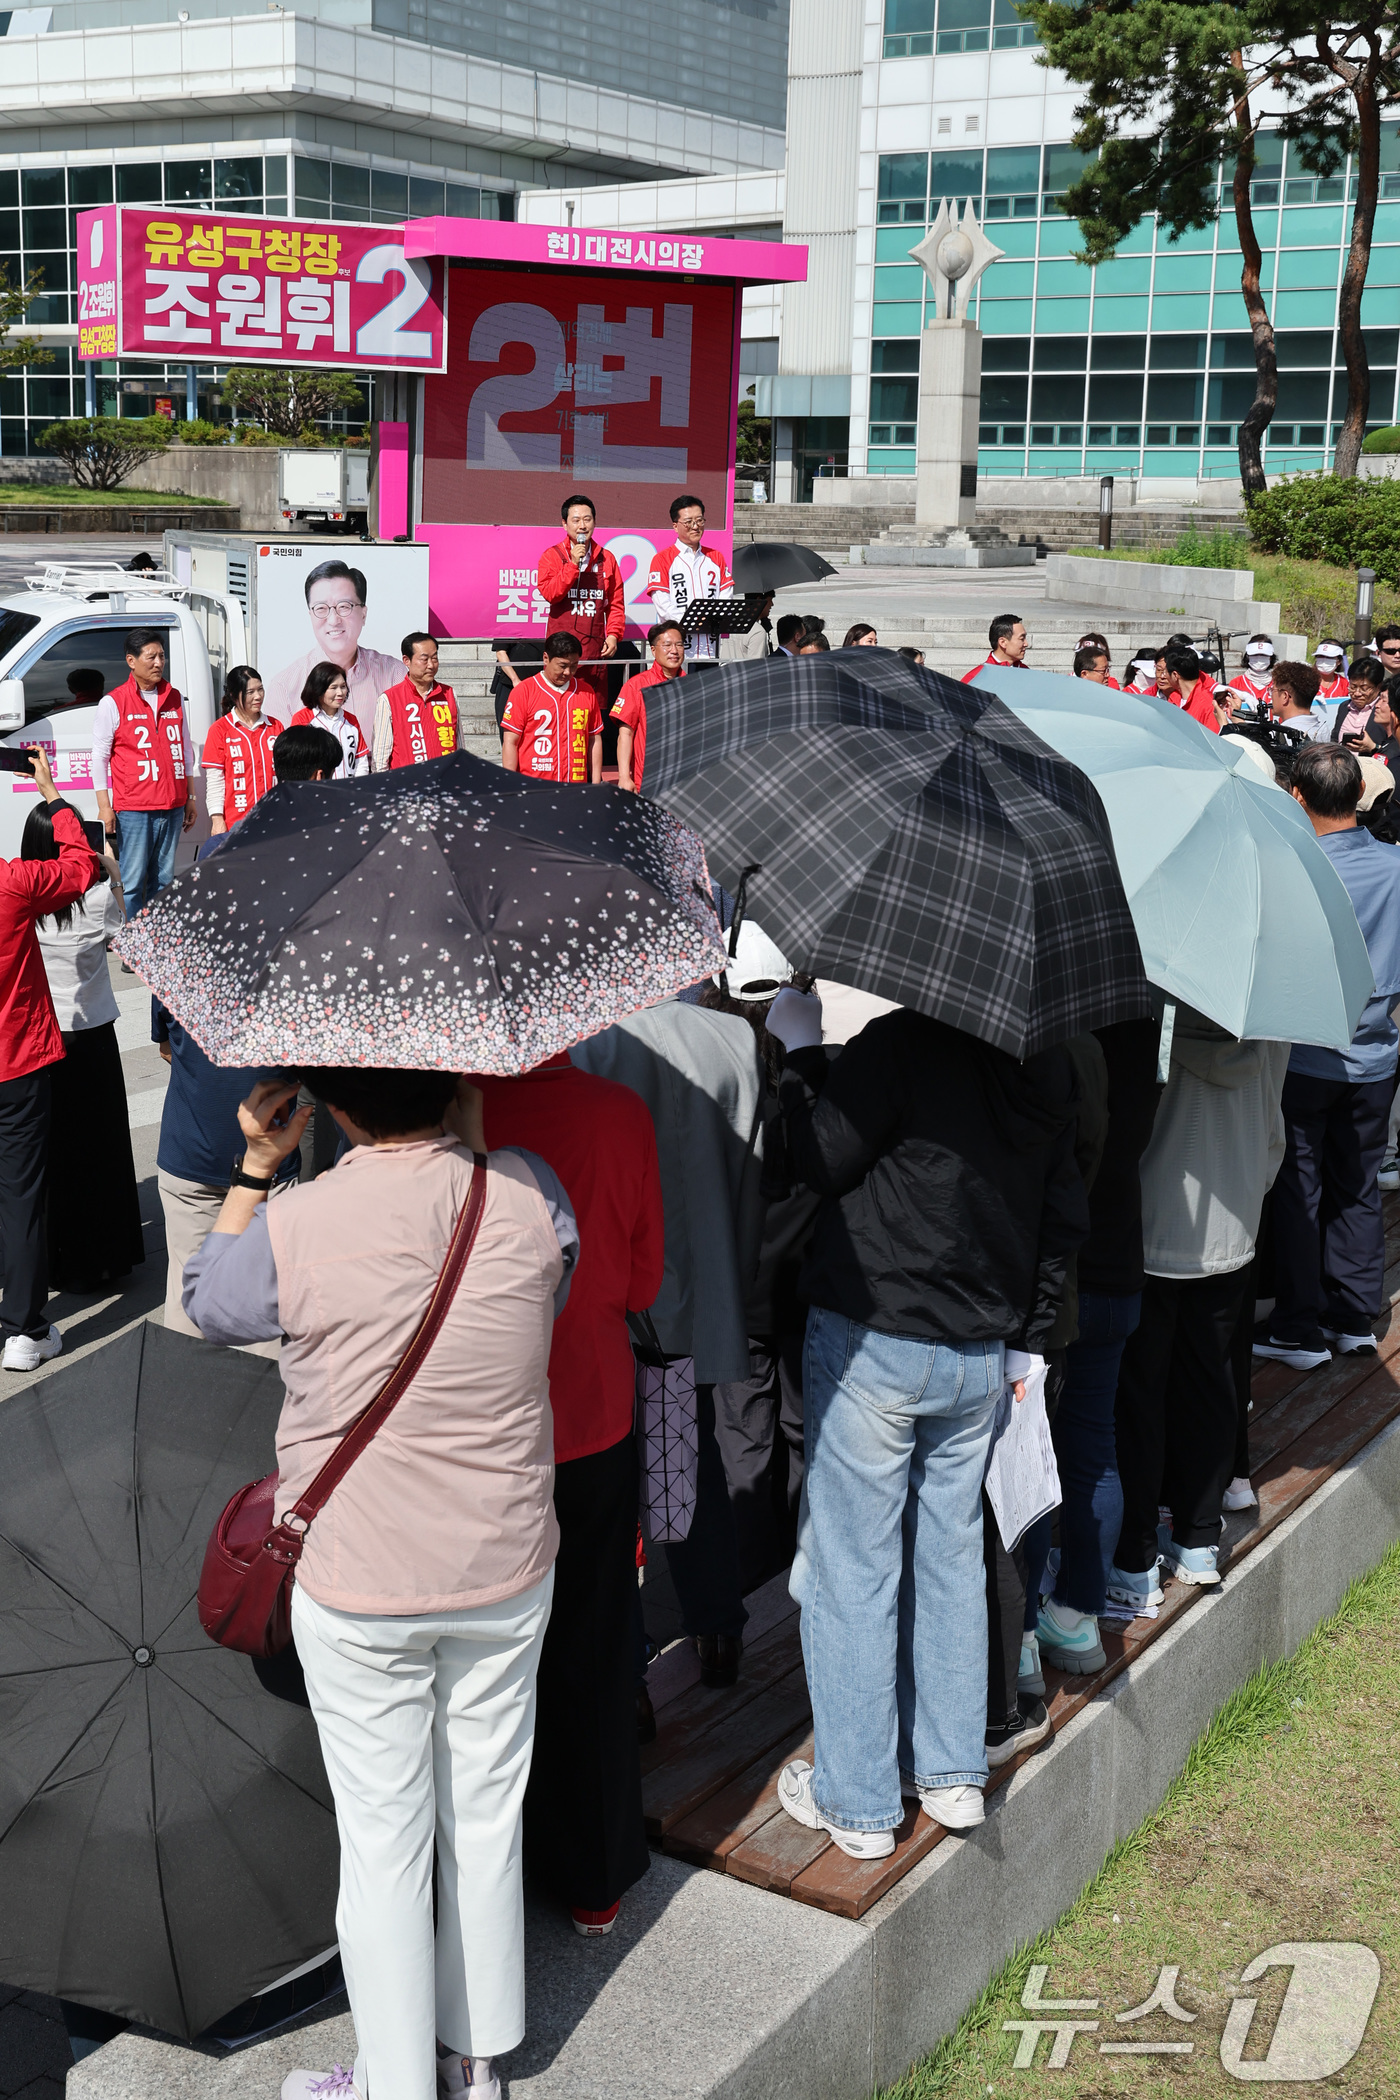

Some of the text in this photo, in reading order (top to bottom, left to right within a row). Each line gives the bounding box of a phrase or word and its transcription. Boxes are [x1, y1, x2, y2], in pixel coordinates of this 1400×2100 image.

[145, 221, 342, 276] 유성구청장
[144, 244, 433, 358] 조원휘 2
[80, 323, 116, 355] 유성구청장
[466, 302, 694, 484] 2번
[273, 547, 302, 557] 국민의힘
[707, 570, 716, 587] 2
[571, 600, 597, 617] 자유
[405, 703, 421, 722] 2
[505, 701, 513, 714] 2
[432, 705, 455, 756] 여황
[533, 709, 553, 736] 2
[537, 740, 549, 752] 가
[572, 708, 589, 781] 최석근
[229, 745, 247, 808] 비례대표
